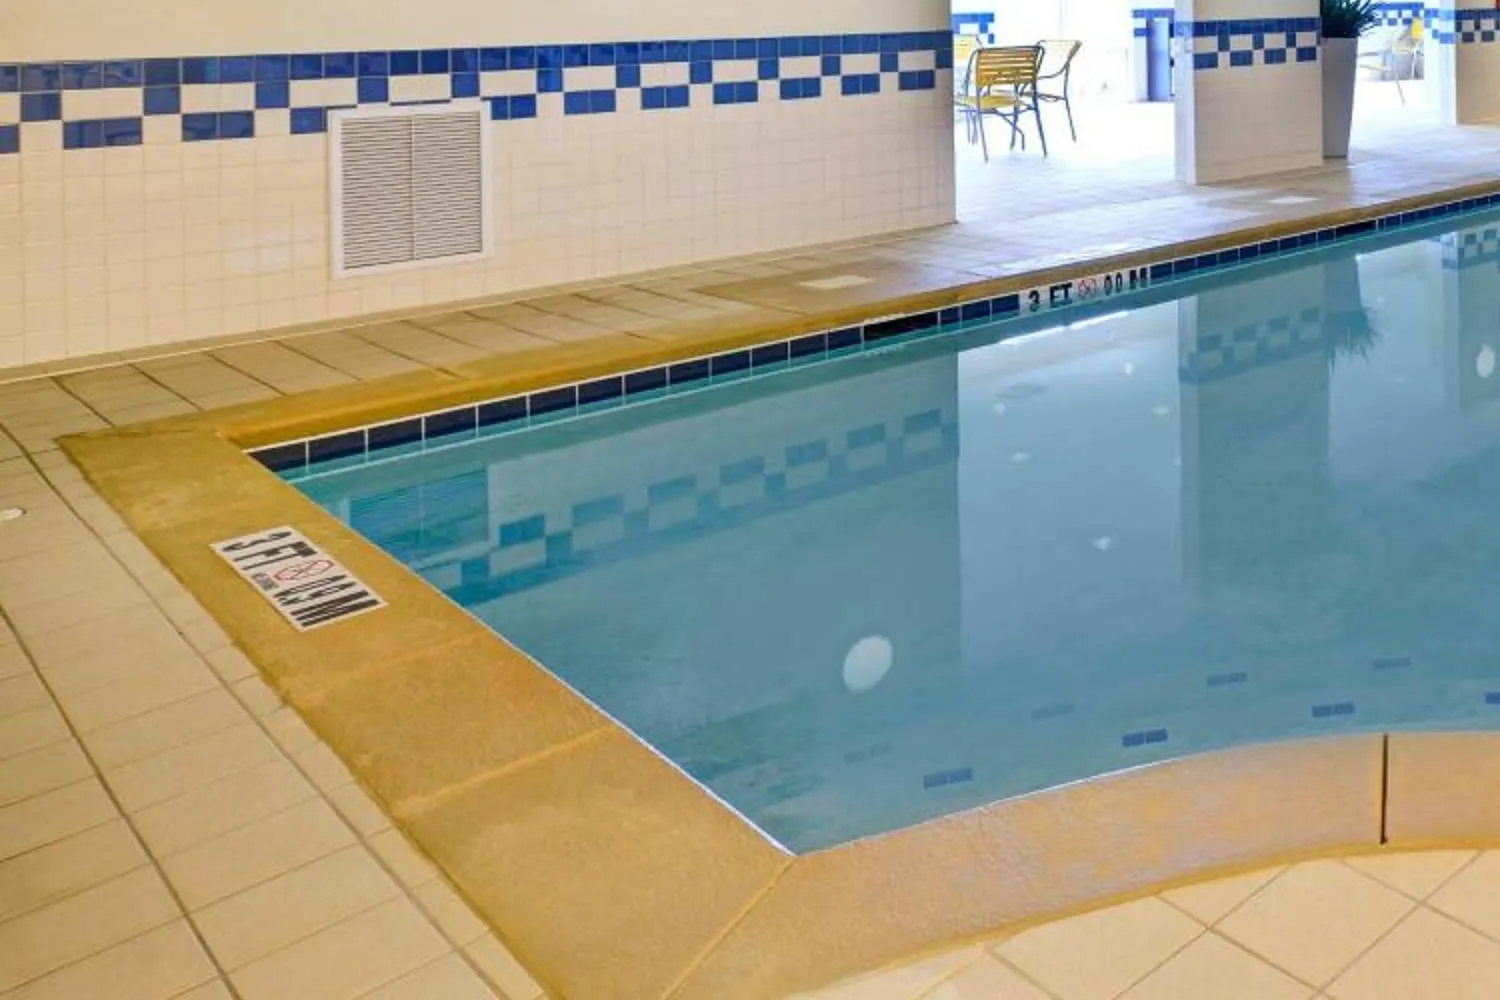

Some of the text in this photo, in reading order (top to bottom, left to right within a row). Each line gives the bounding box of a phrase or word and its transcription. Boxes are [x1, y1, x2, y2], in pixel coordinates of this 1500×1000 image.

[1049, 282, 1072, 308] FT
[222, 531, 293, 552] 3
[233, 541, 317, 571] FT
[290, 590, 381, 627] M
